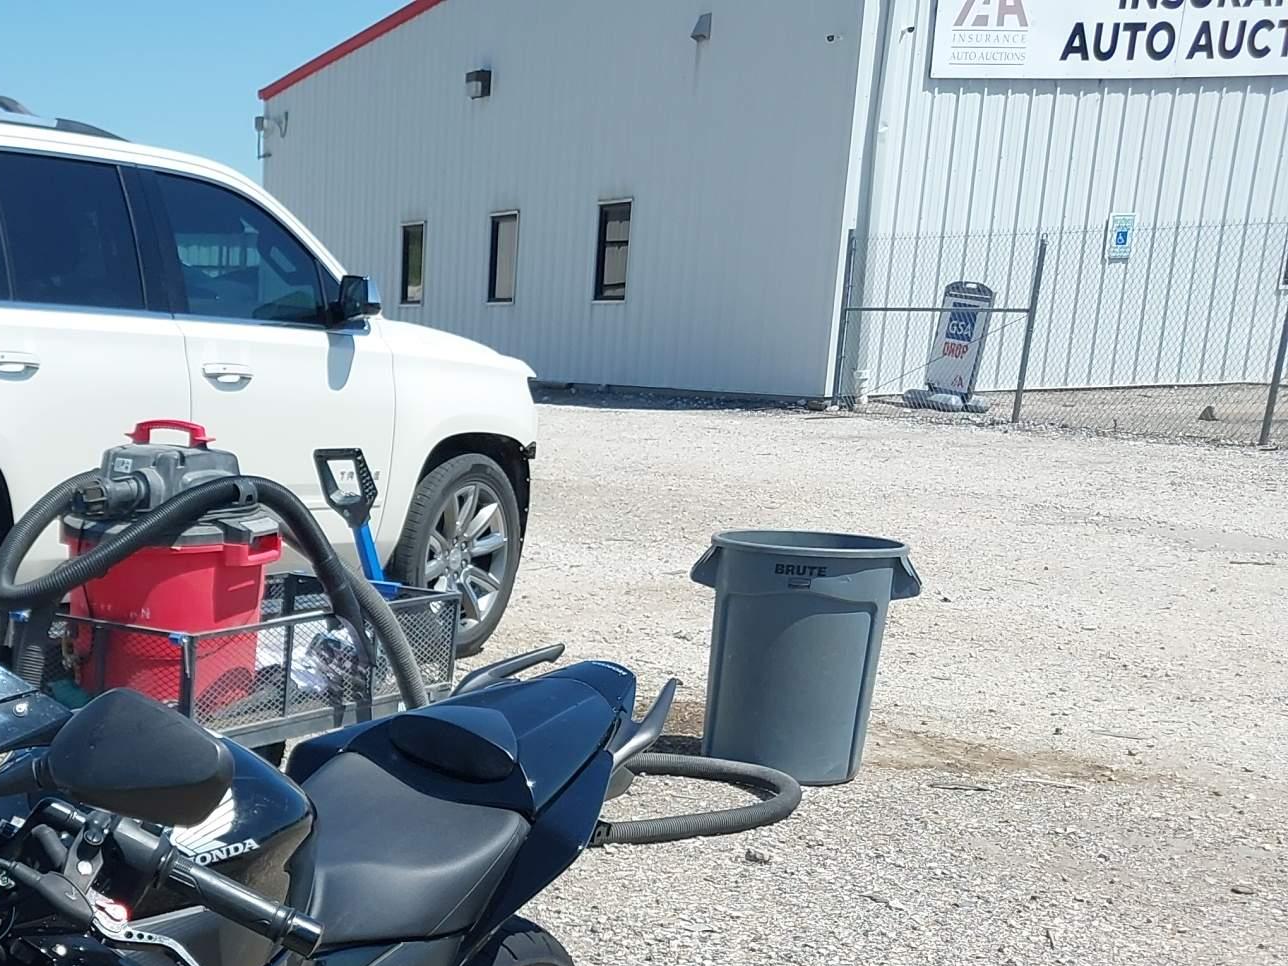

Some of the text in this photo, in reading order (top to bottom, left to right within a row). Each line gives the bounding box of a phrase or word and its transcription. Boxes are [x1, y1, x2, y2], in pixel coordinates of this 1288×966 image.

[952, 33, 1028, 43] INSURANCE
[1059, 21, 1176, 62] AUTO
[949, 51, 1026, 62] AUTO AUCTIONS
[948, 320, 973, 337] GSA
[942, 341, 969, 359] DROP
[775, 563, 827, 577] BRUTE
[190, 838, 261, 867] ONDA
